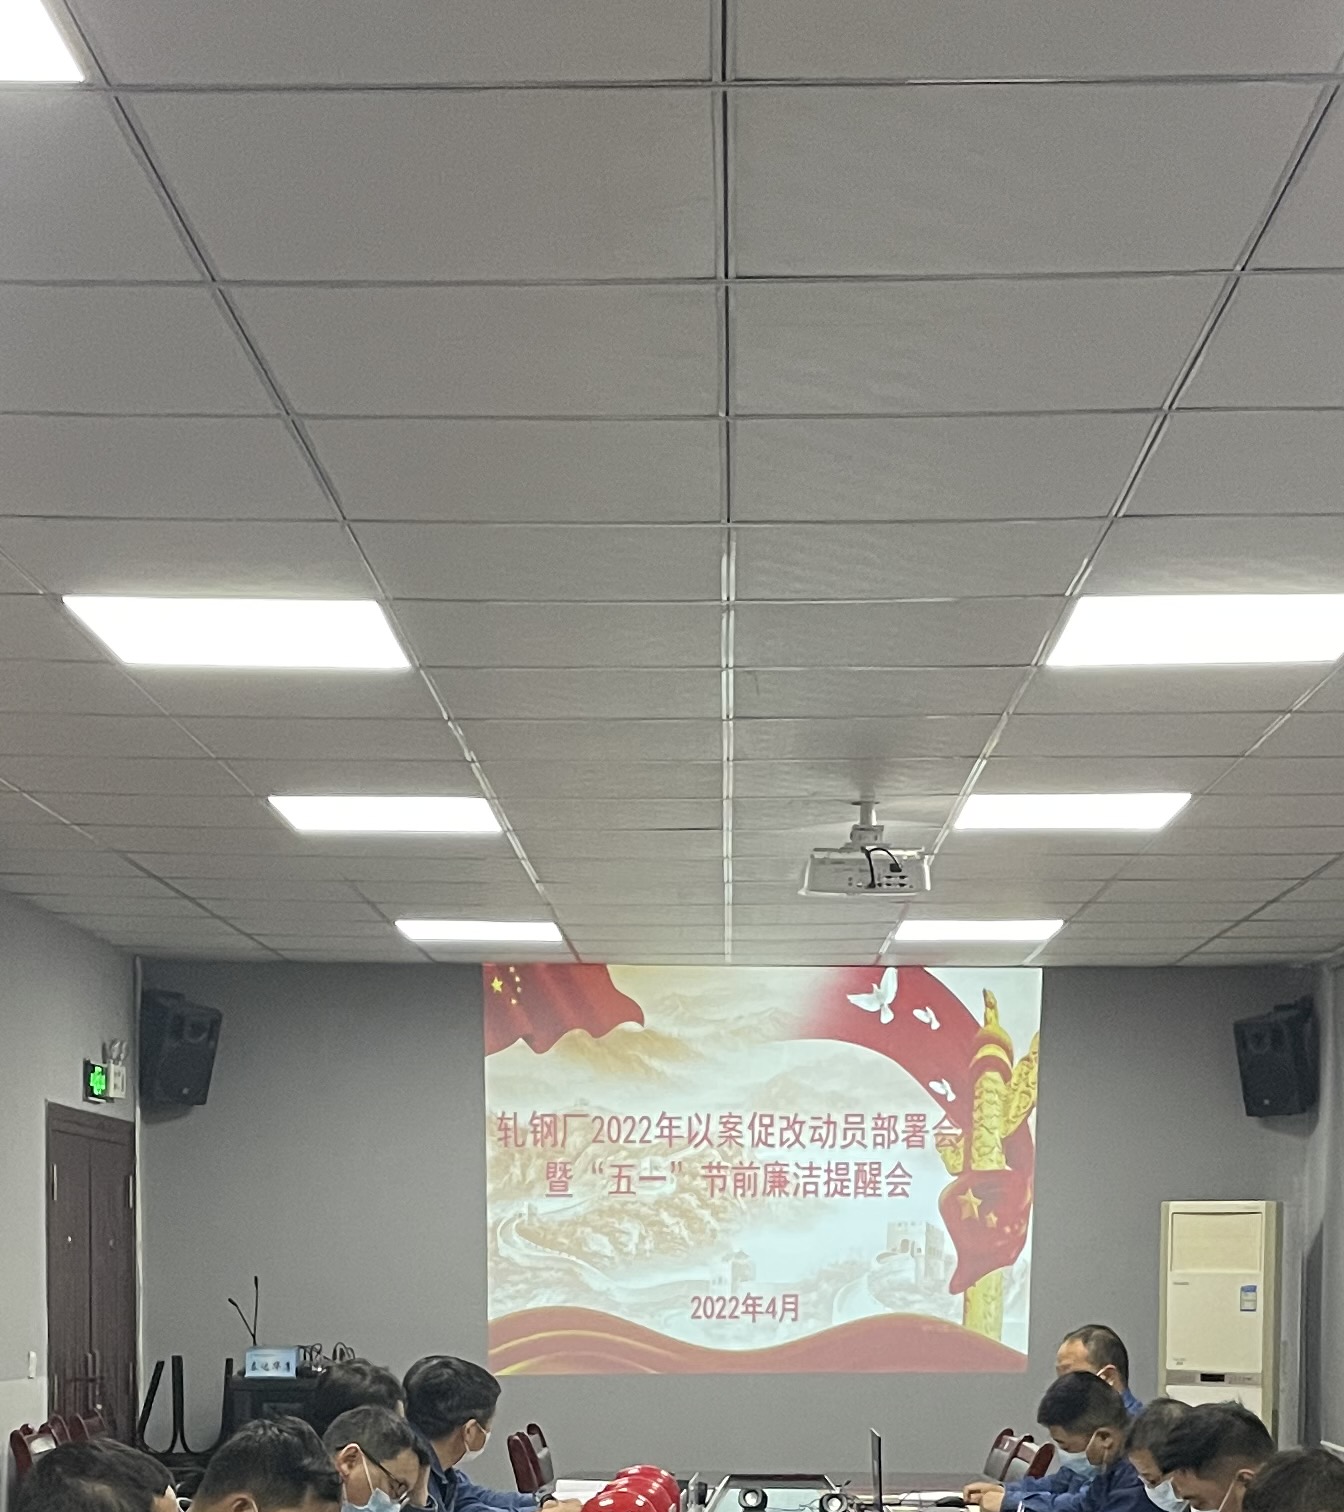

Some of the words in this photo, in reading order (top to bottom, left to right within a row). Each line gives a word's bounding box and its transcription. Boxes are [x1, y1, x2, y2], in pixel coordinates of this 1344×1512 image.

[496, 1111, 964, 1149] 轧钢厂2022年以案促改动员部署会
[690, 1293, 800, 1324] 2022年4月
